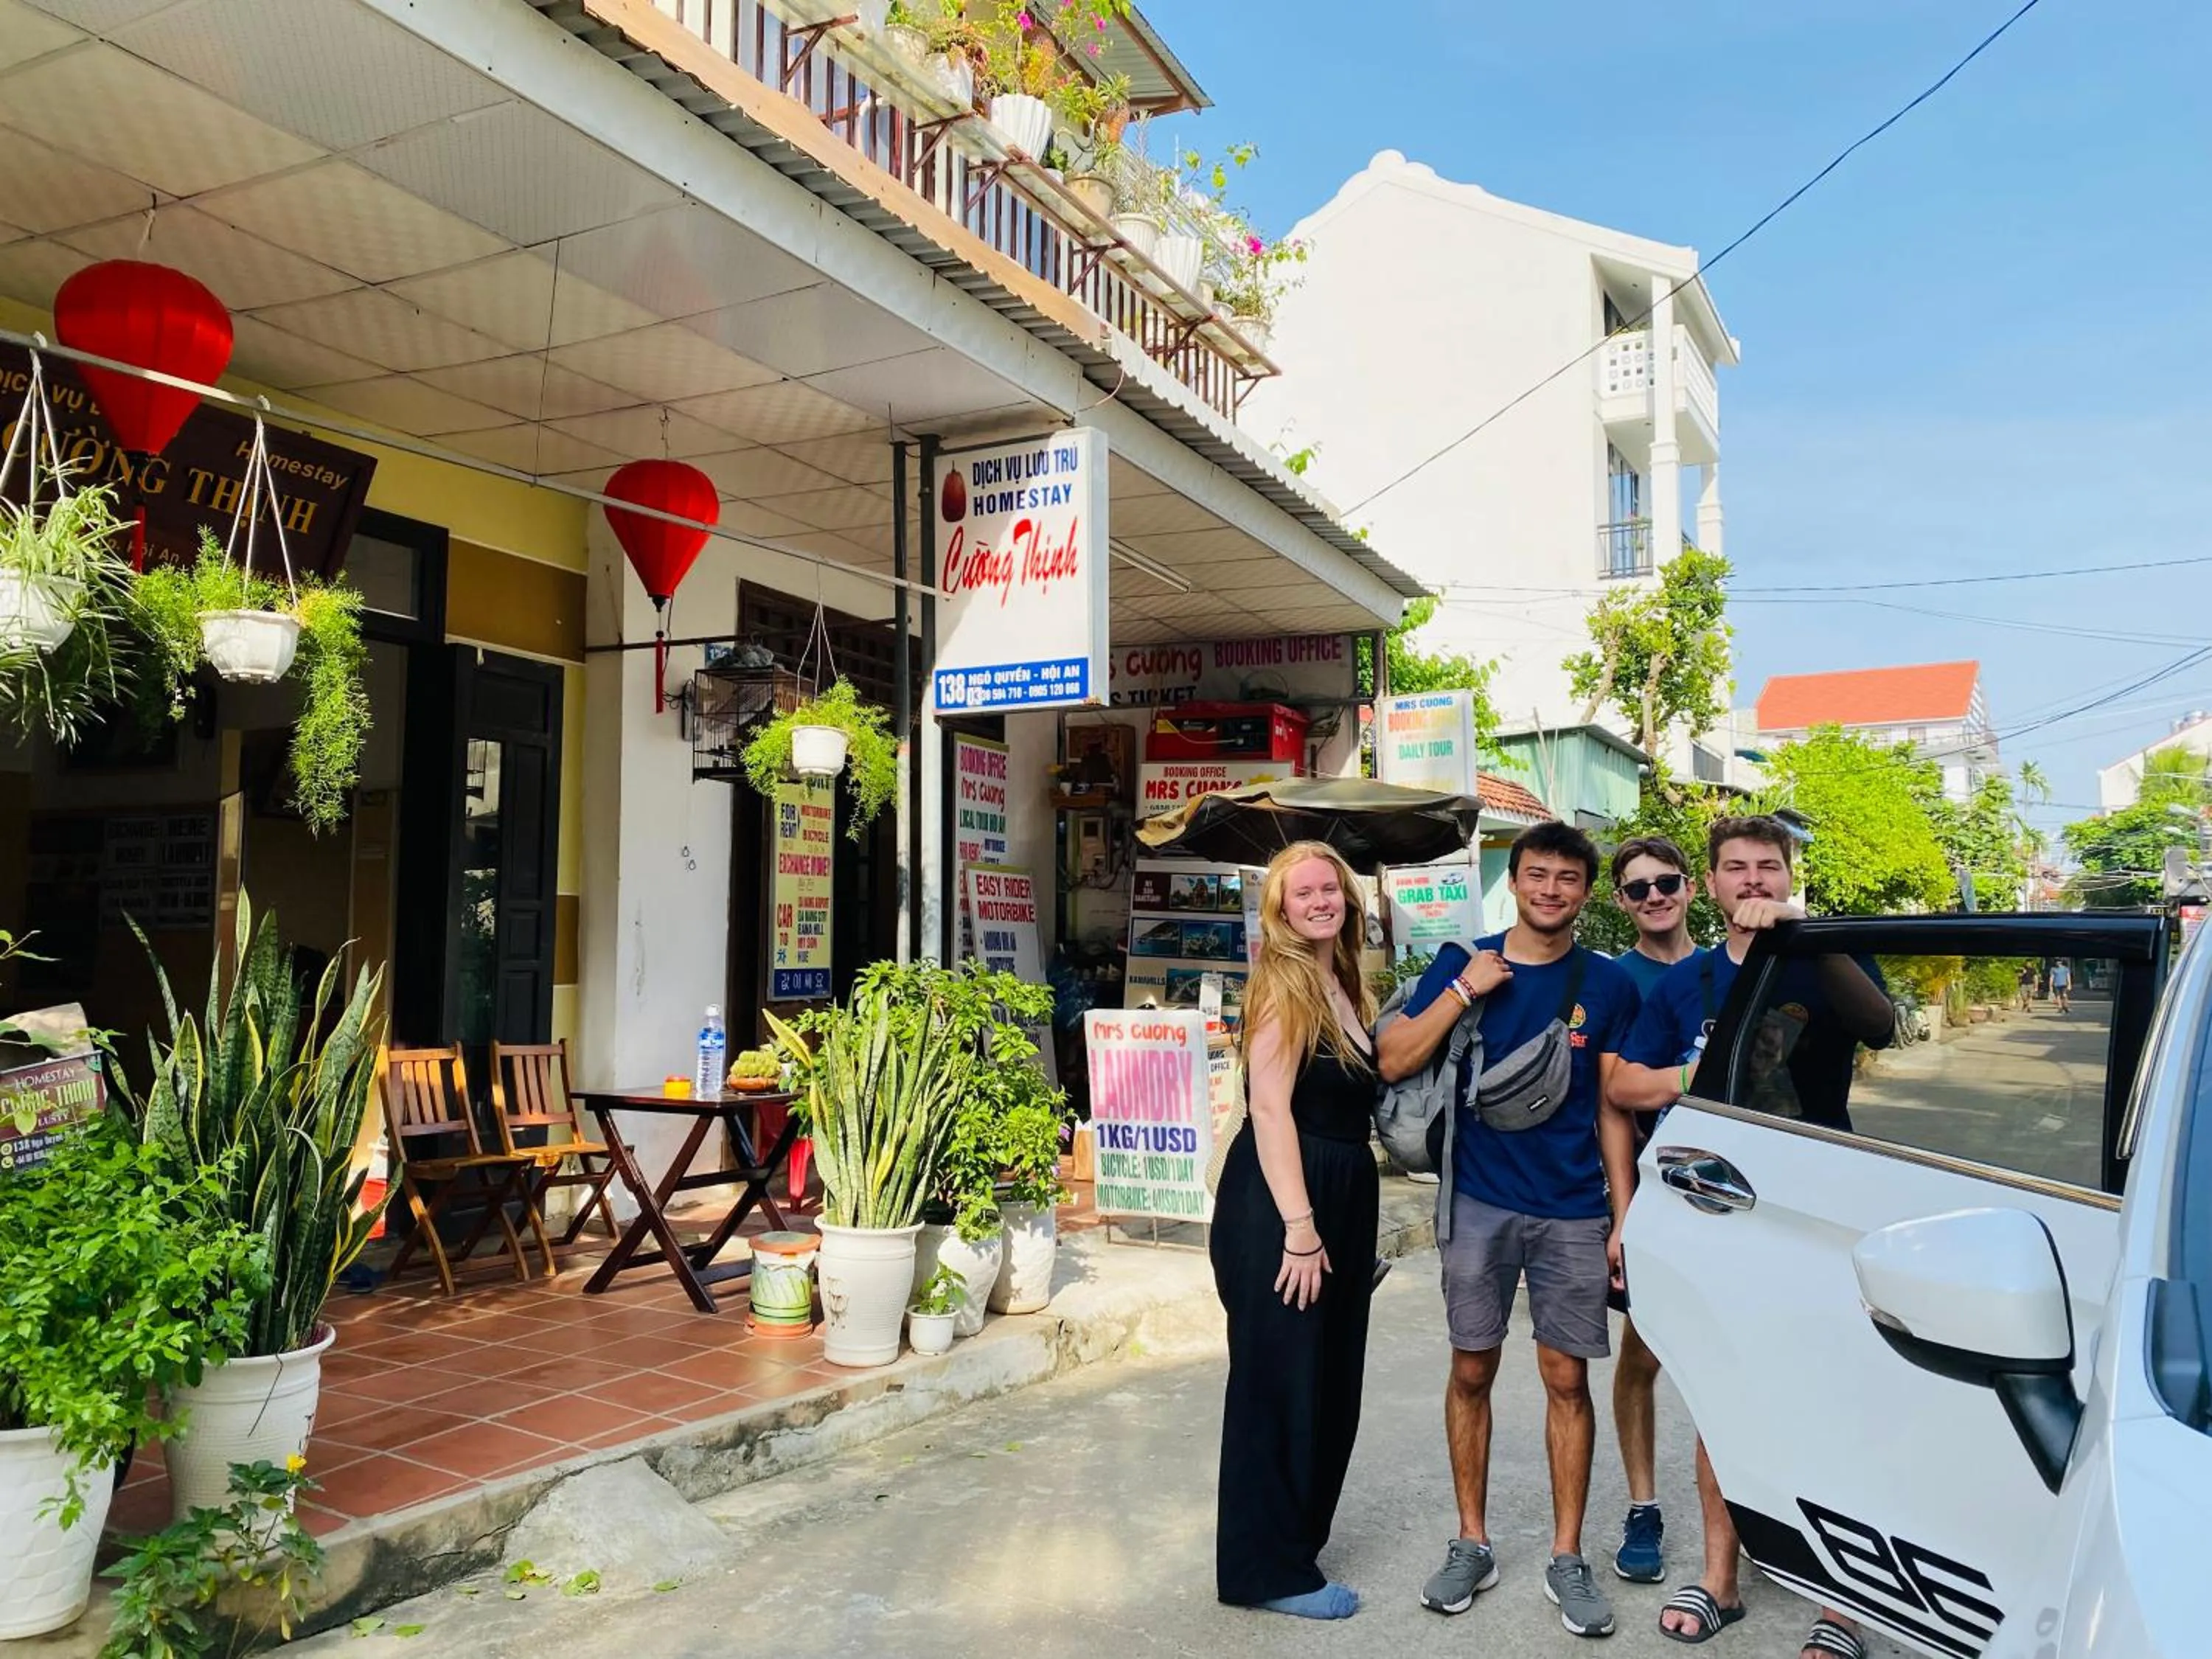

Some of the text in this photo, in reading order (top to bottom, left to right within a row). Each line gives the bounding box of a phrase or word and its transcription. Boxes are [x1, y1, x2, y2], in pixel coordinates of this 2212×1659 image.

[235, 440, 349, 490] Hmestay
[973, 458, 1002, 490] DỊCH
[1005, 454, 1022, 484] VỤ
[186, 467, 319, 535] THỊNH
[973, 484, 1073, 517] HOMESTAY
[942, 515, 1080, 608] Cường Thịnh
[1215, 639, 1282, 667] BOOKING
[1287, 634, 1342, 662] OFFICE
[1063, 664, 1080, 678] AN
[1395, 696, 1453, 709] MRS CUONG
[1398, 740, 1454, 760] DAILY TOUR
[1164, 766, 1227, 778] BOOKING OFFICE
[1145, 780, 1180, 800] MRS
[781, 803, 796, 821] FOR
[975, 874, 1001, 897] EASY
[1004, 877, 1032, 899] RIDER
[1397, 884, 1468, 904] GRAB TAXI
[777, 903, 793, 928] CAR
[978, 900, 1036, 922] MOTORBIKE
[779, 932, 788, 946] TO
[15, 1066, 74, 1089] HOMESTAY
[1091, 1049, 1192, 1122] LAUNDRY
[1096, 1124, 1197, 1153] 1KG/1USD
